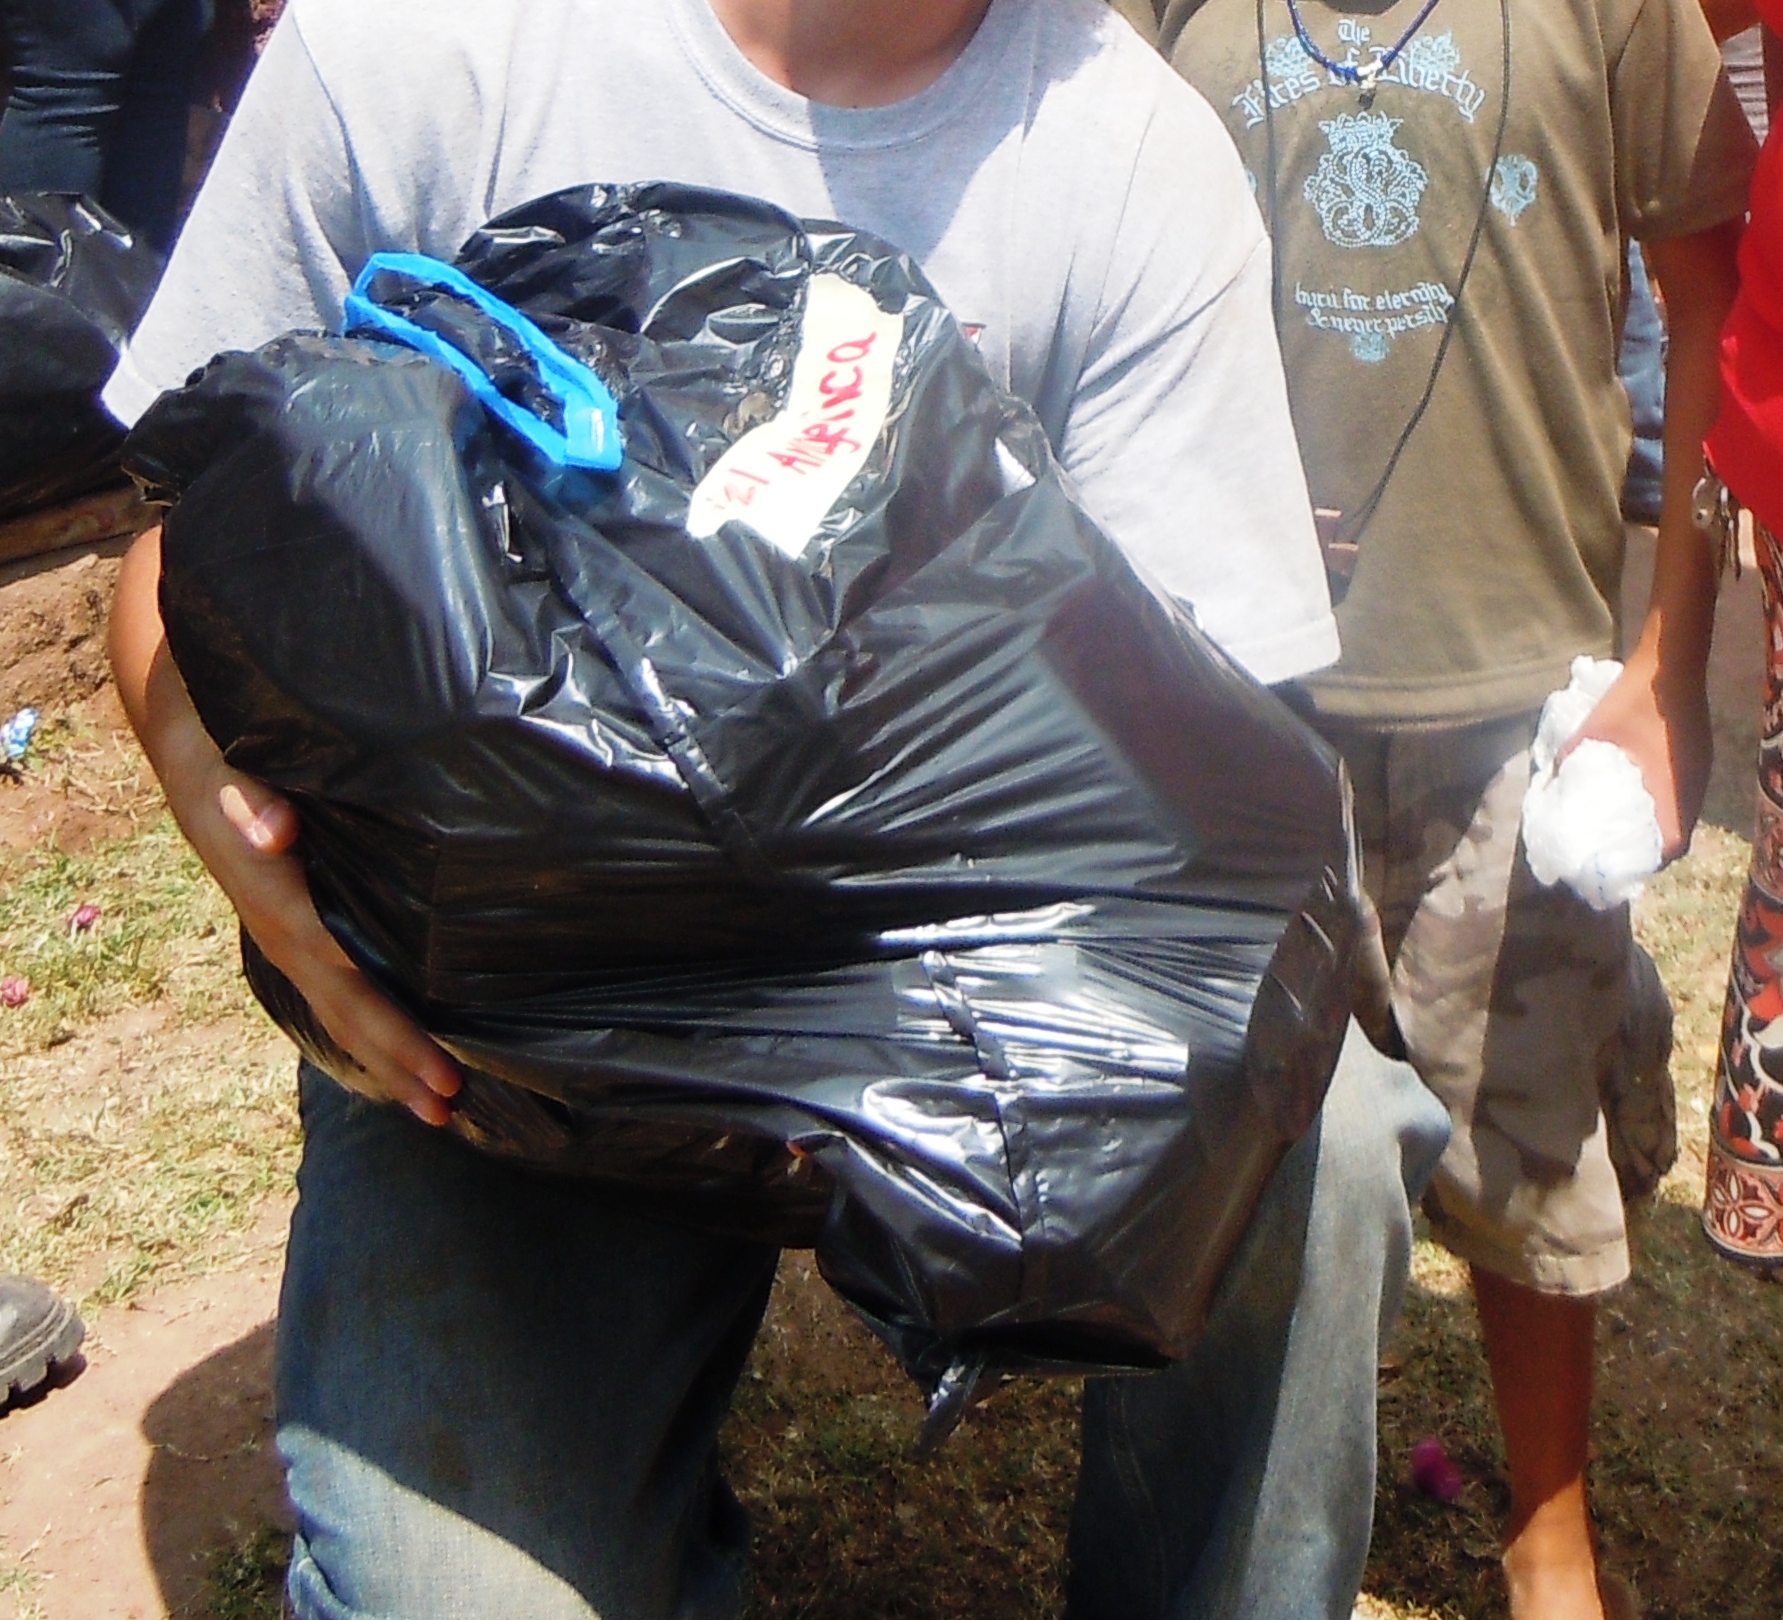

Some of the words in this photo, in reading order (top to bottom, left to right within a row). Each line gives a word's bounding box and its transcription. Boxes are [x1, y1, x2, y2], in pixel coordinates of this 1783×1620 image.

[1337, 18, 1371, 47] The
[1231, 71, 1320, 129] Fires
[1368, 45, 1486, 124] Liberty
[1343, 287, 1371, 311] for
[1329, 314, 1383, 336] never
